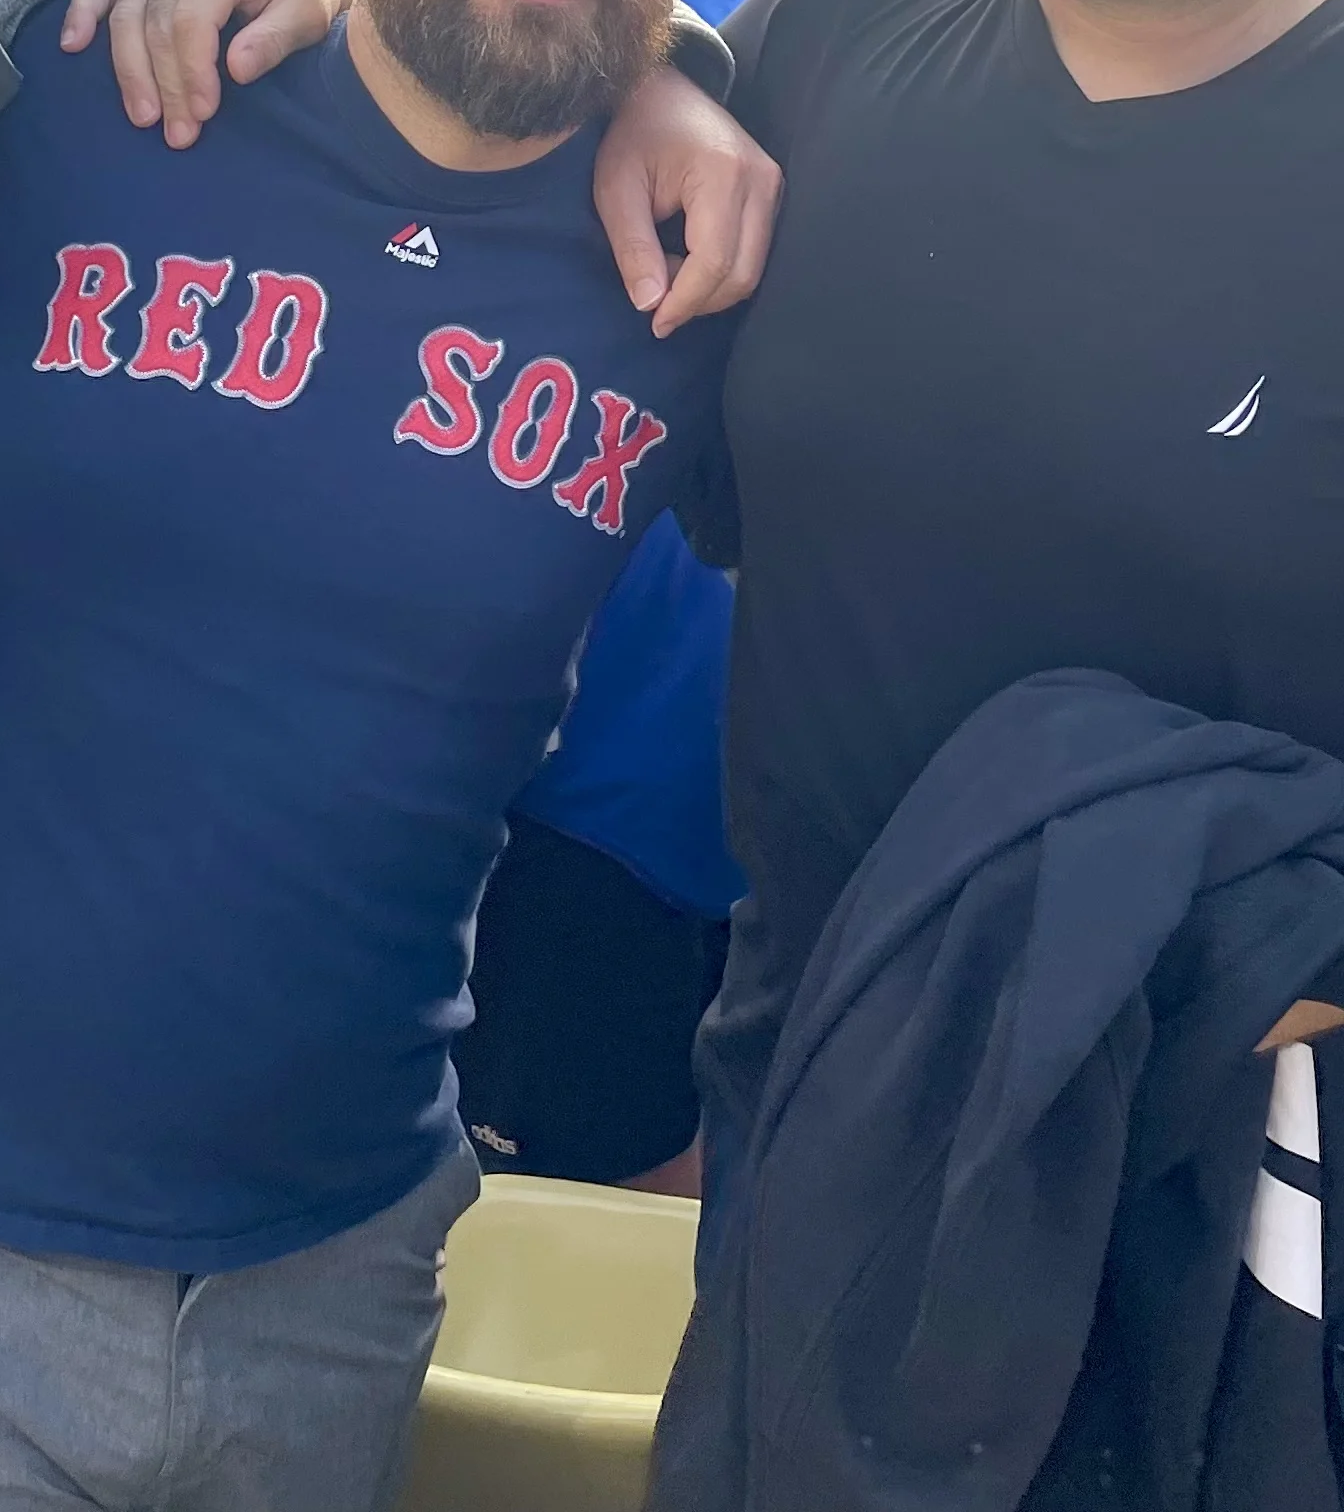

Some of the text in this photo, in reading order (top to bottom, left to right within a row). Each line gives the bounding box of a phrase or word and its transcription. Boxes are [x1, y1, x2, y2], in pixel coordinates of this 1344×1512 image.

[385, 242, 439, 268] Majestic
[32, 243, 667, 535] RED SOX
